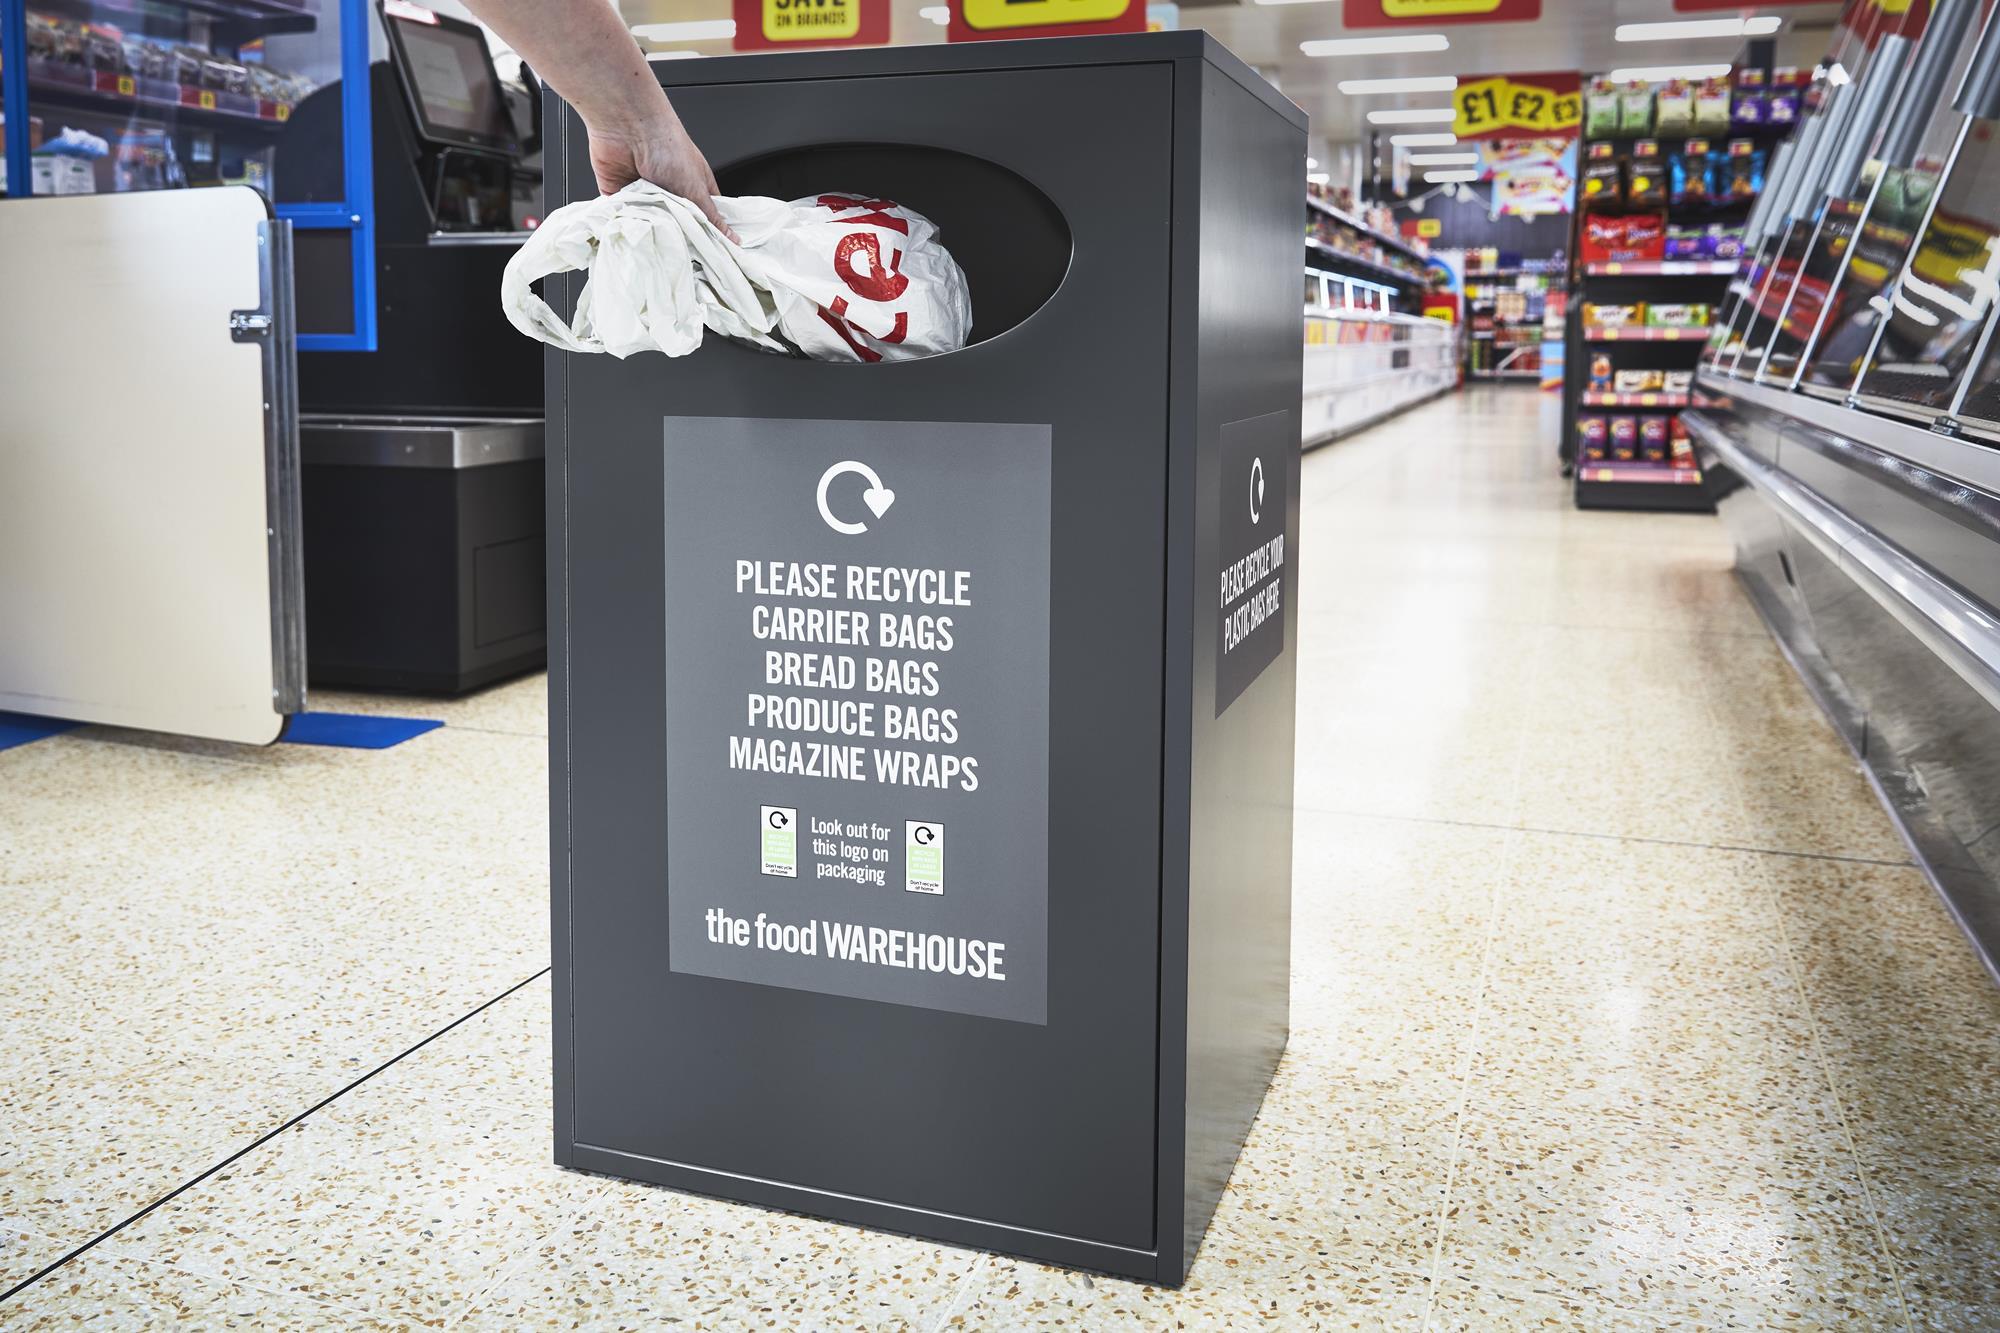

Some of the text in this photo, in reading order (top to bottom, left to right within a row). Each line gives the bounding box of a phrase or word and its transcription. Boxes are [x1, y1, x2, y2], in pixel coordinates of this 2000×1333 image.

[1462, 88, 1498, 125] £1
[1511, 91, 1545, 121] £2
[737, 560, 971, 606] PLEASE RECYCLE
[1221, 534, 1284, 608] PLEASE RECYCLE YOUR
[752, 605, 954, 651] CARRIER BAGS
[1225, 578, 1280, 654] PLASTIC BAGS HERE
[766, 650, 939, 696] BREAD BAGS
[748, 694, 958, 744] PRODUCE BAGS
[729, 736, 978, 791] MAGAZINE WRAPS
[812, 817, 890, 840] Look out for
[813, 839, 888, 862] this logo on
[817, 862, 885, 886] packaging
[705, 908, 1006, 980] the food WAREHOUSE
